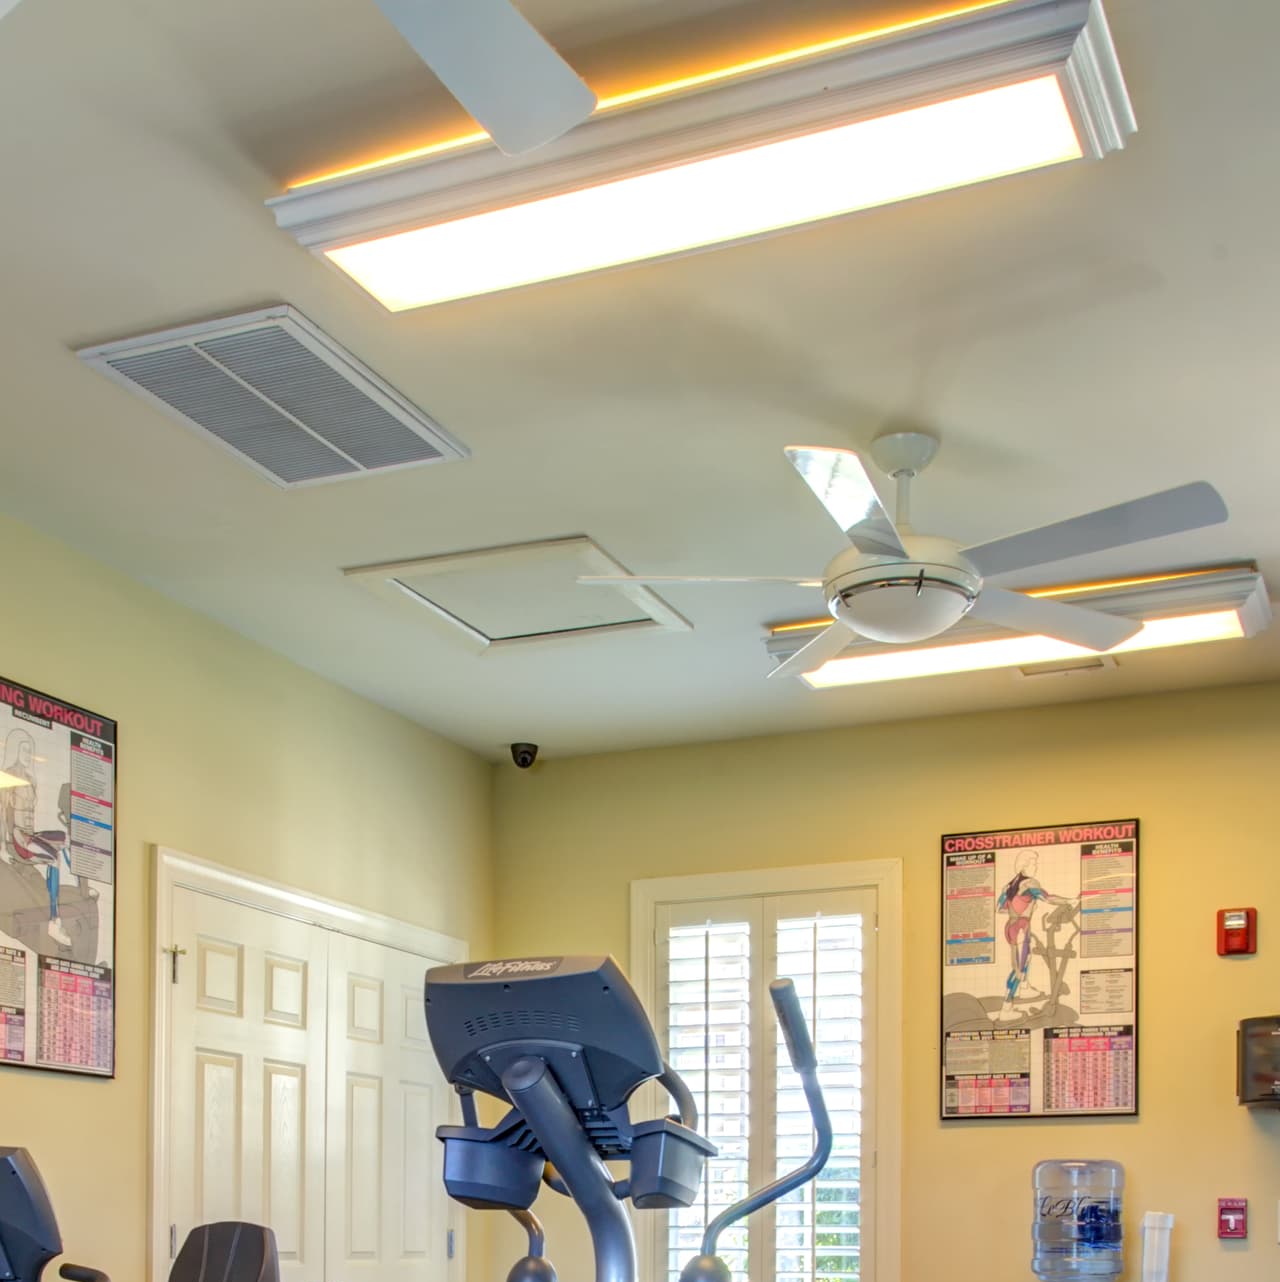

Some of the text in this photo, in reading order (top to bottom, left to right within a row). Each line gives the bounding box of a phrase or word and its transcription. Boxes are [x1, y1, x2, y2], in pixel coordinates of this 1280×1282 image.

[29, 694, 103, 737] WORKOUT
[945, 824, 1135, 852] CROSSTRAINER WORKOUT
